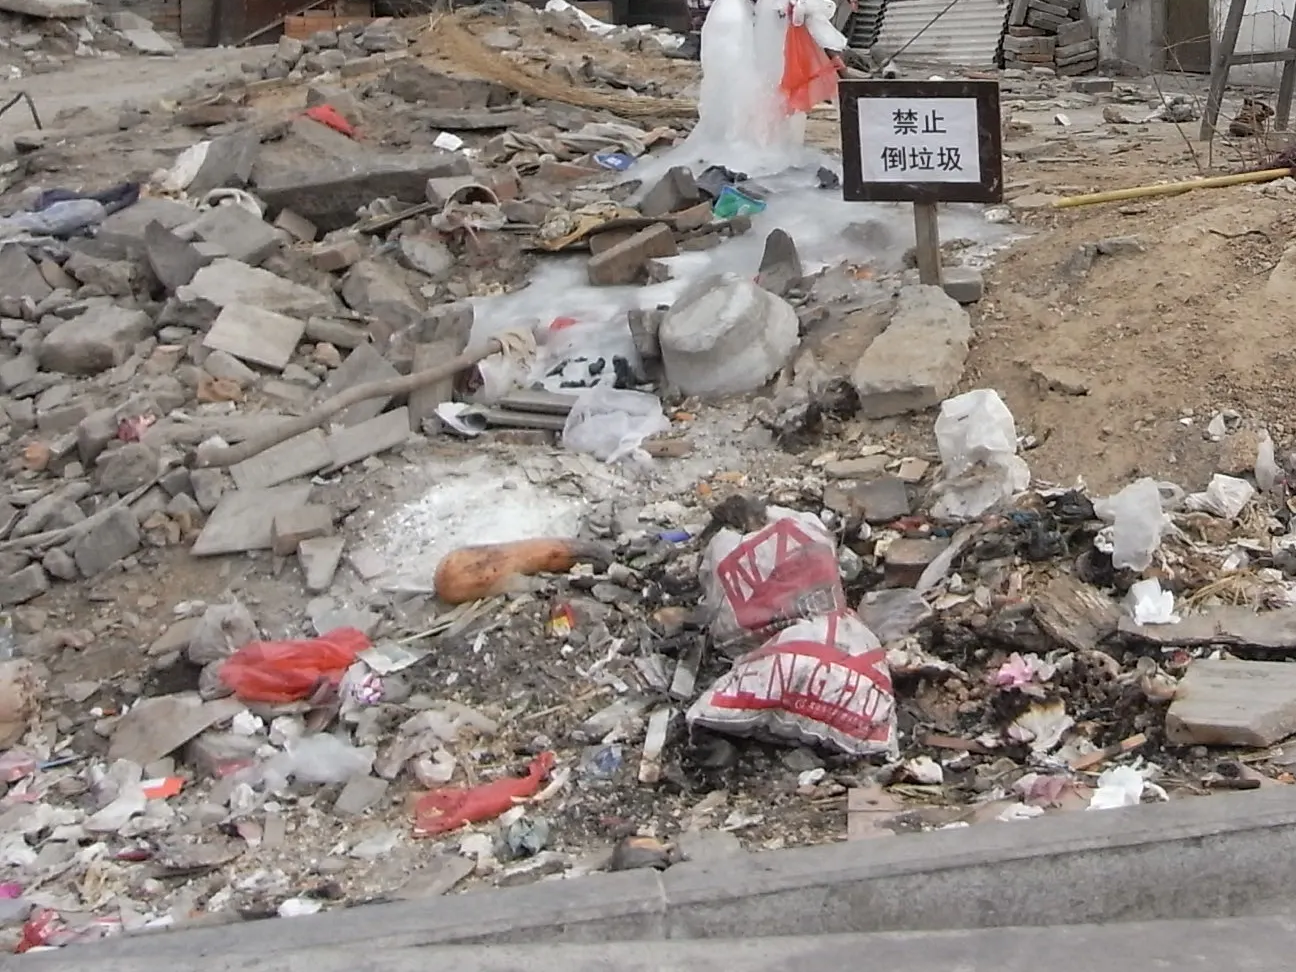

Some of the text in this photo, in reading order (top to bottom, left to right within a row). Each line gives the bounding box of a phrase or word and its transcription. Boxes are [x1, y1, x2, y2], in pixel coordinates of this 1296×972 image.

[892, 108, 947, 135] 禁止
[880, 146, 963, 172] 倒垃圾
